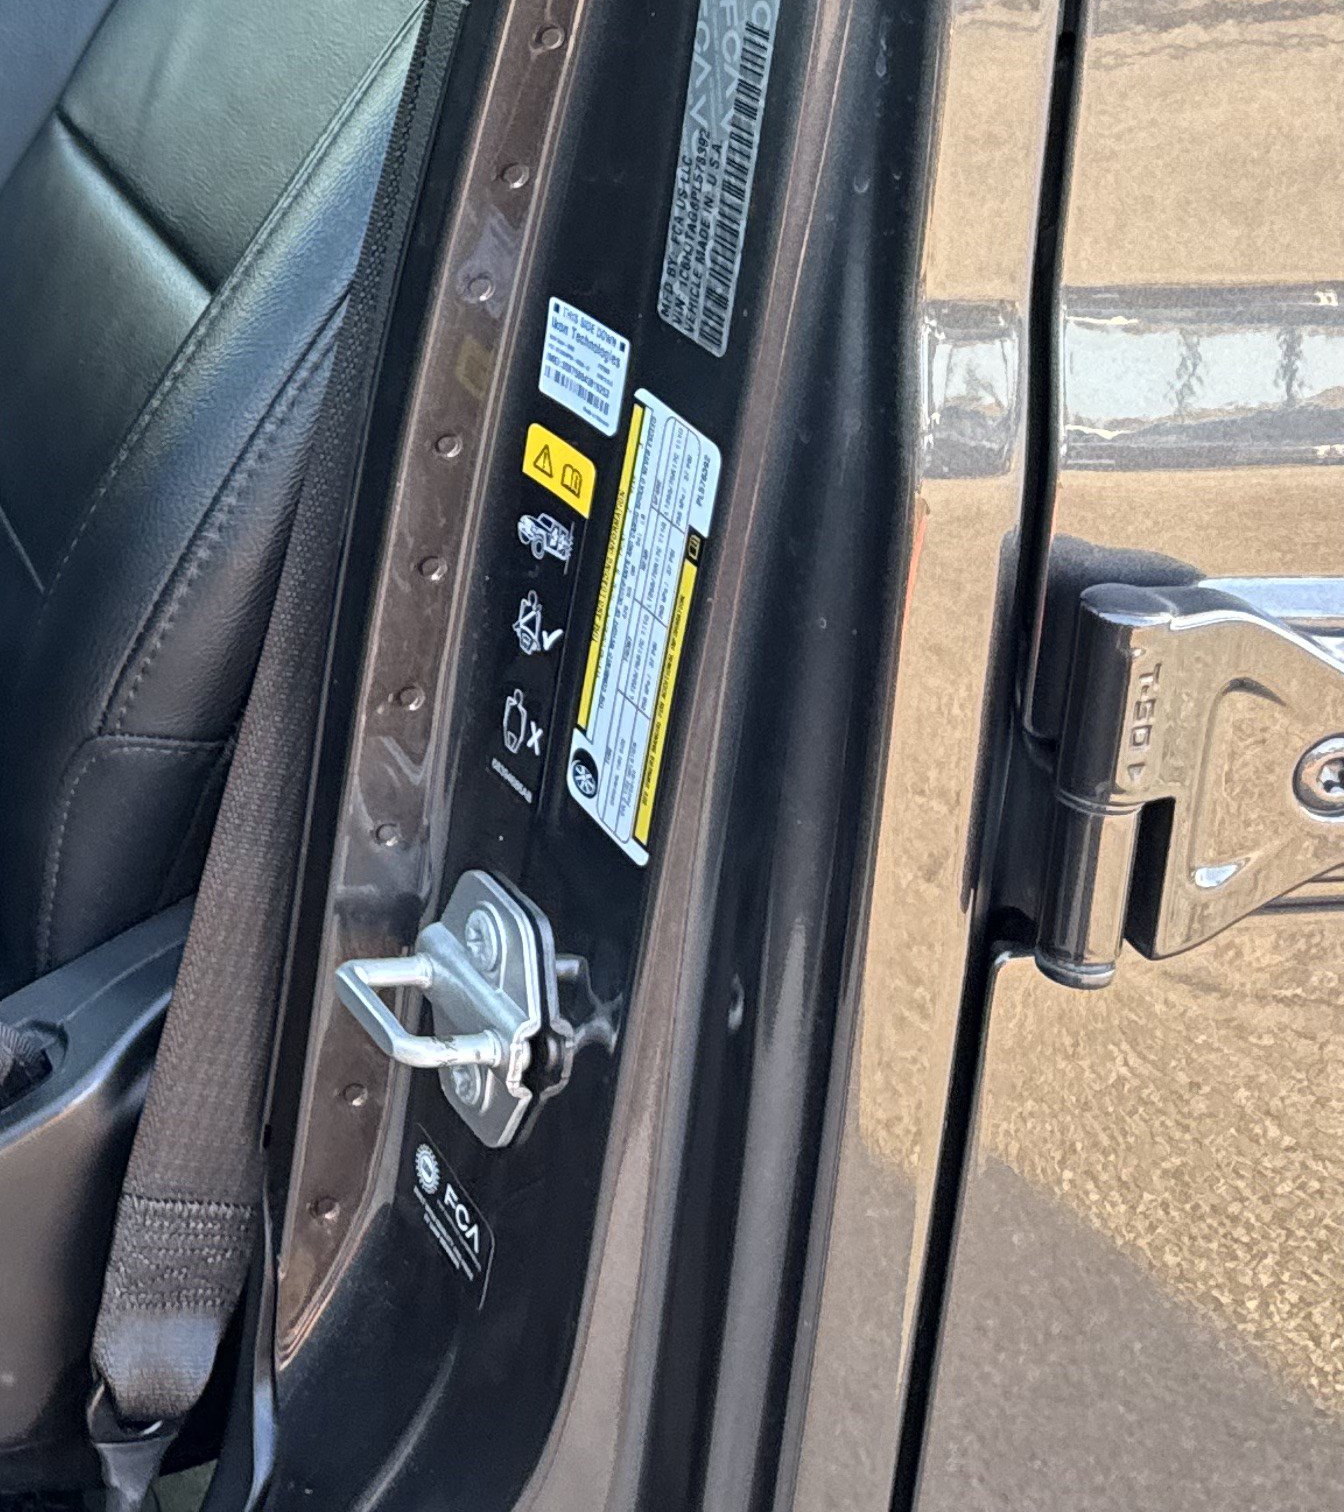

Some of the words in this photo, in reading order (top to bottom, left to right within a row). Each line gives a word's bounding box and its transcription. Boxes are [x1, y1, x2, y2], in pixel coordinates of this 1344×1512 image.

[675, 186, 687, 211] US
[670, 212, 684, 246] FCA
[683, 266, 702, 335] VEHICLE
[694, 217, 710, 266] MADE
[660, 279, 674, 318] MFD
[444, 1183, 480, 1255] FCA
